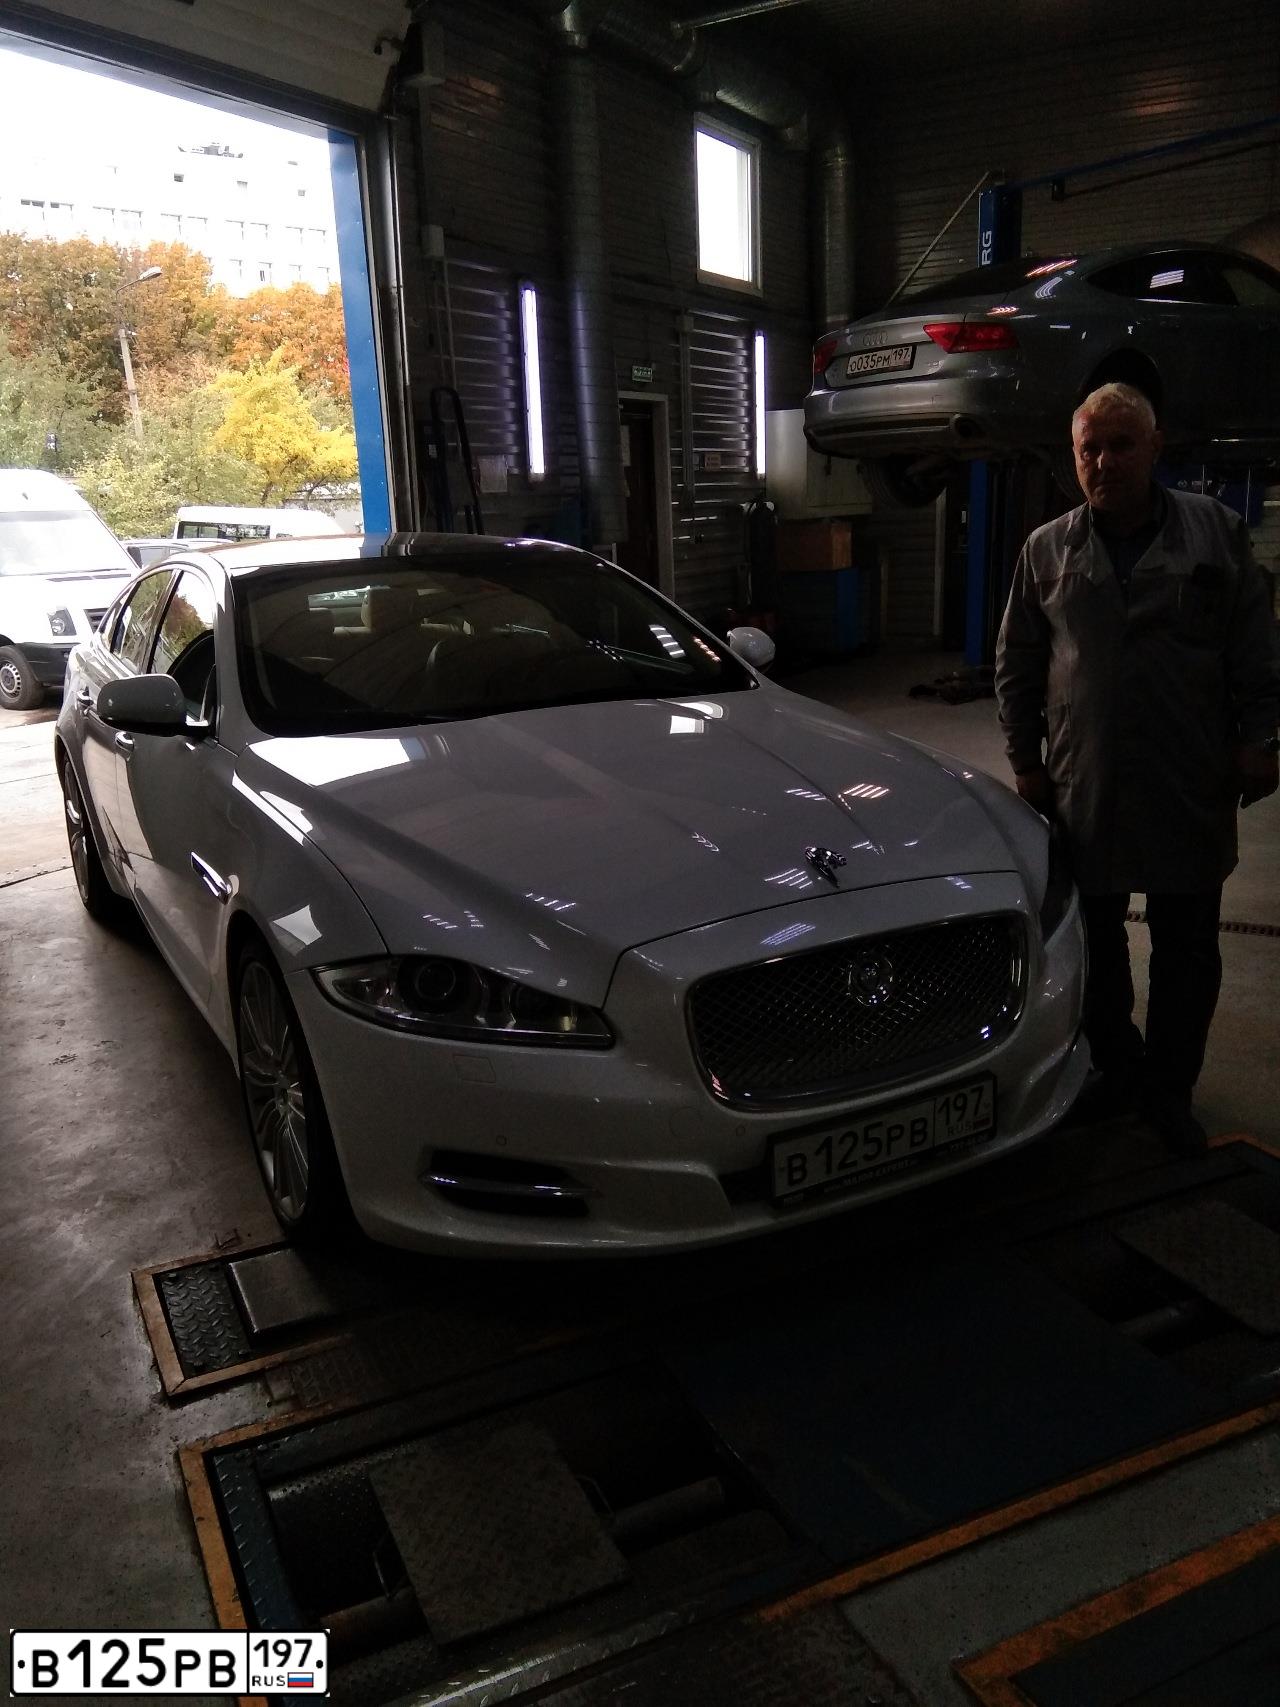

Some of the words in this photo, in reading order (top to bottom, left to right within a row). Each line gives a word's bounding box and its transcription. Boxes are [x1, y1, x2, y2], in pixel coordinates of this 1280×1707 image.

[892, 347, 910, 361] 197
[938, 1086, 984, 1126] 197
[947, 1121, 977, 1137] RUS
